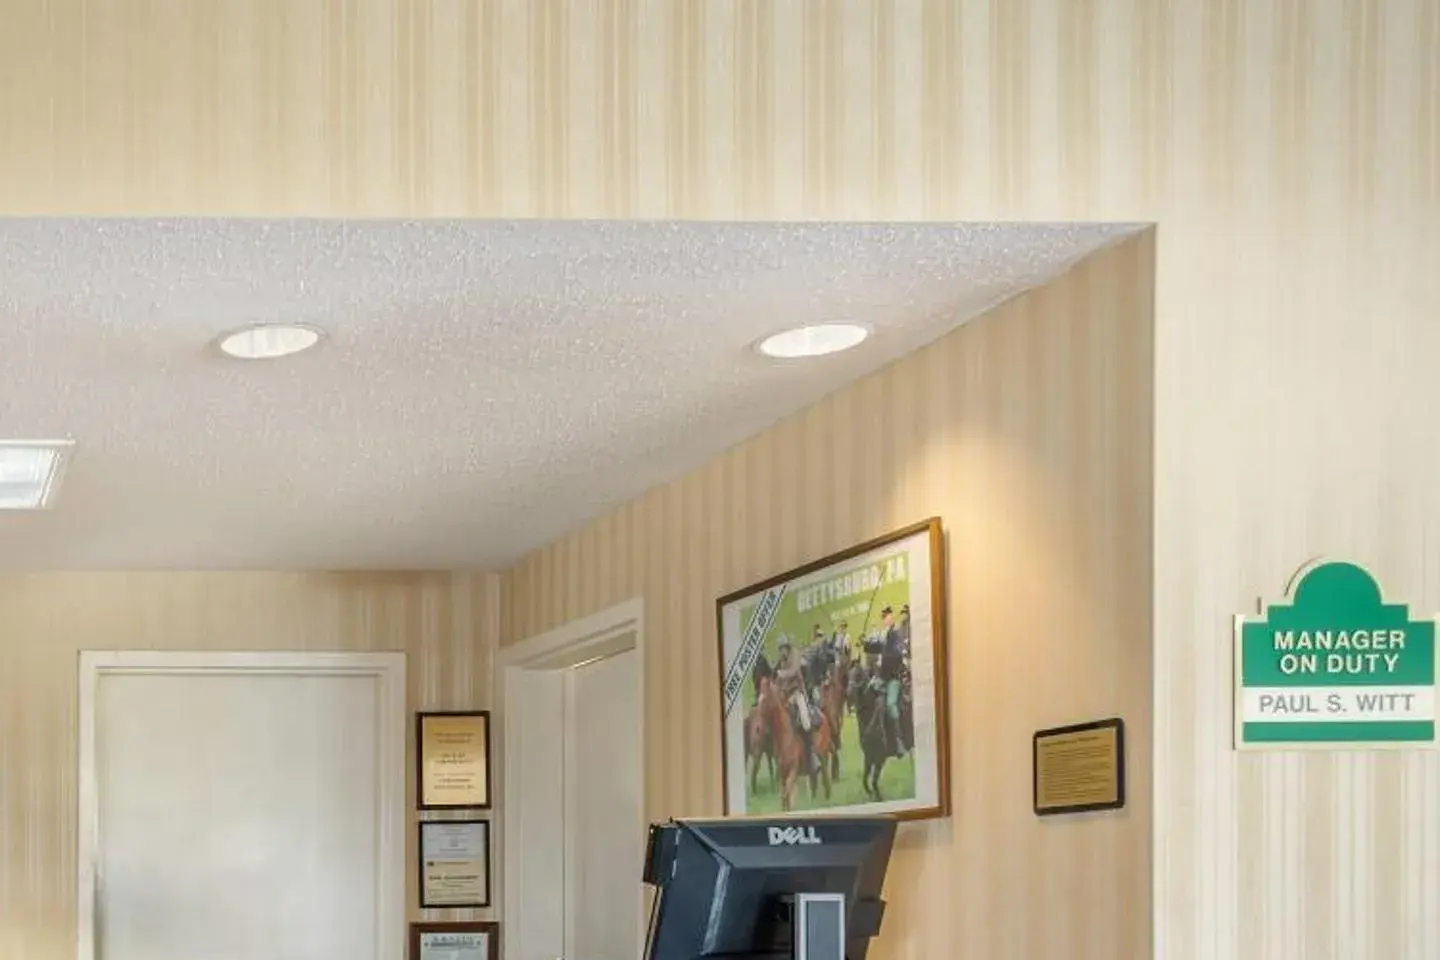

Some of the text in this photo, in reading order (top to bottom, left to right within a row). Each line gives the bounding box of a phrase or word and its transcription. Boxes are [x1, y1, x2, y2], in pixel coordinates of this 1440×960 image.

[1274, 629, 1406, 650] MANAGER
[1279, 653, 1400, 674] ON DUTY
[1259, 693, 1416, 713] PAUL S. WITT
[767, 826, 823, 846] DELL
